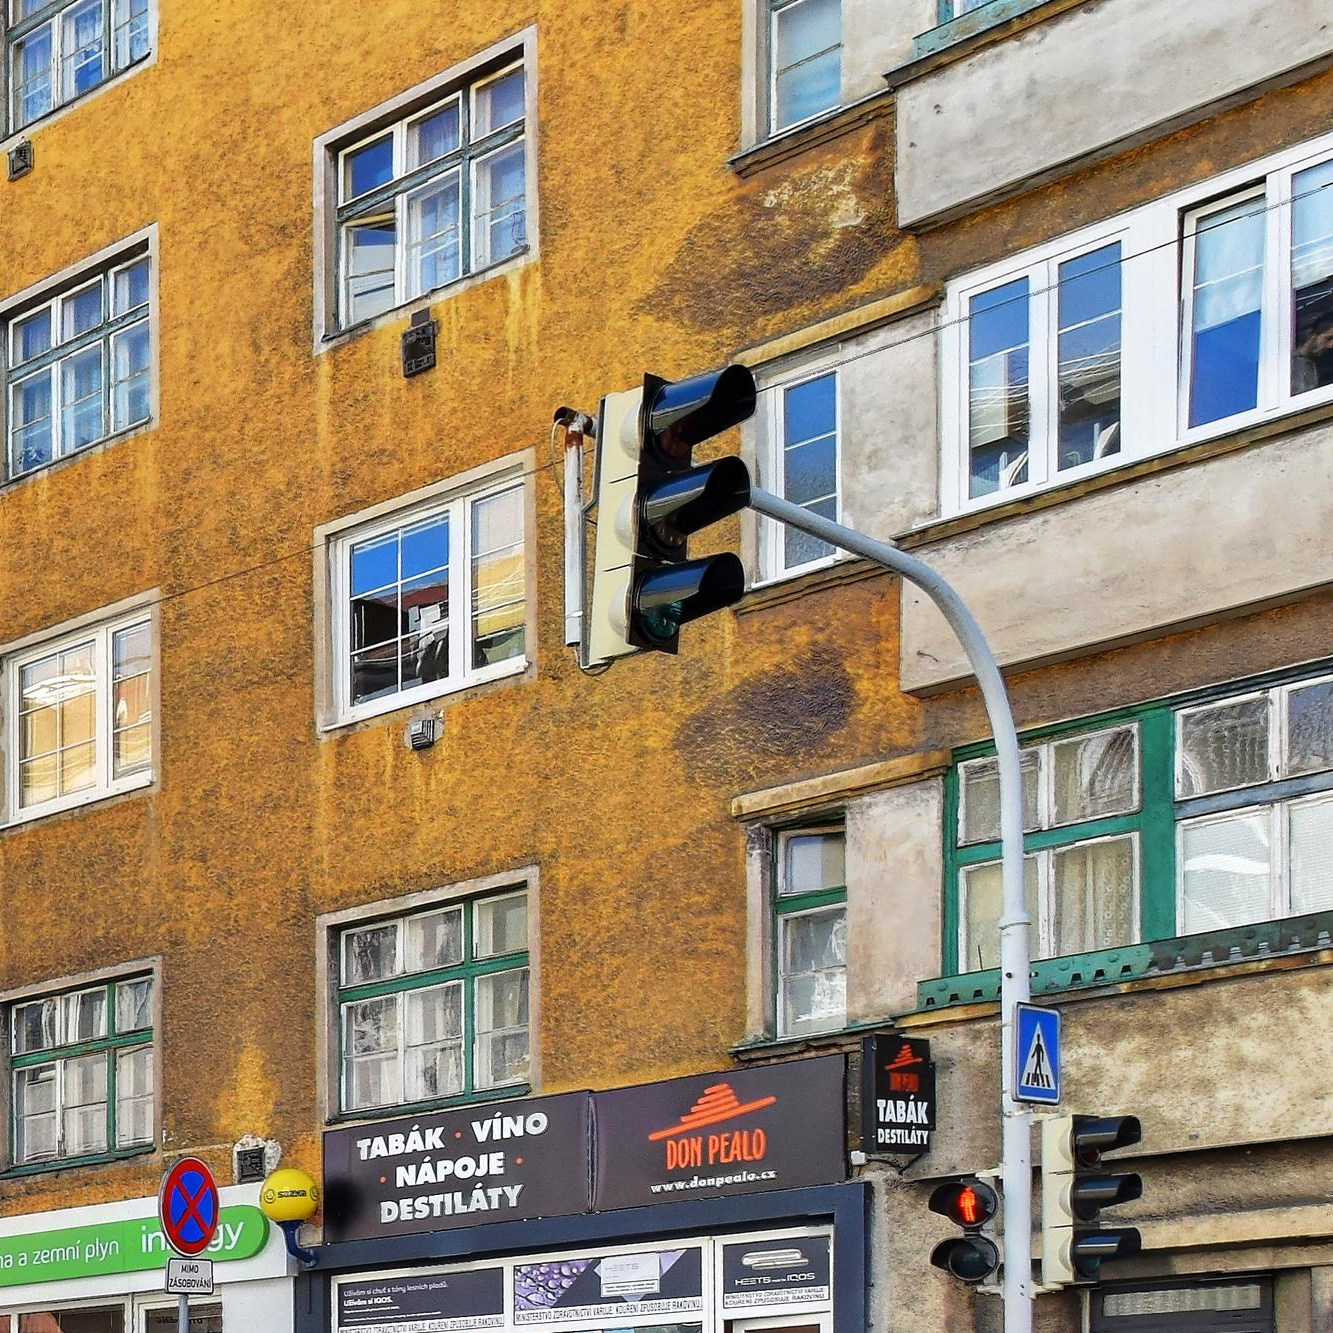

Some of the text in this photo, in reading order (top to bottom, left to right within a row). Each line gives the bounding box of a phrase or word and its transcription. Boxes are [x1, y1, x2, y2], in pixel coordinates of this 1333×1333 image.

[876, 1094, 929, 1124] TABÁK
[357, 1111, 548, 1160] TABÁK VÍNO
[666, 1128, 767, 1170] DON PEALO
[877, 1126, 929, 1144] DESTILÁTY
[396, 1152, 506, 1187] NÁPOJE
[650, 1170, 778, 1193] www.donpealo.cz
[380, 1182, 524, 1223] DESTILÁTY
[18, 1252, 27, 1266] a
[32, 1239, 81, 1265] zemní
[85, 1237, 119, 1265] plyn
[141, 1221, 244, 1253] ingy
[169, 1277, 211, 1288] ZÁSOBOVÁNÍ
[181, 1265, 199, 1273] MIMO
[787, 1272, 815, 1282] IQOS
